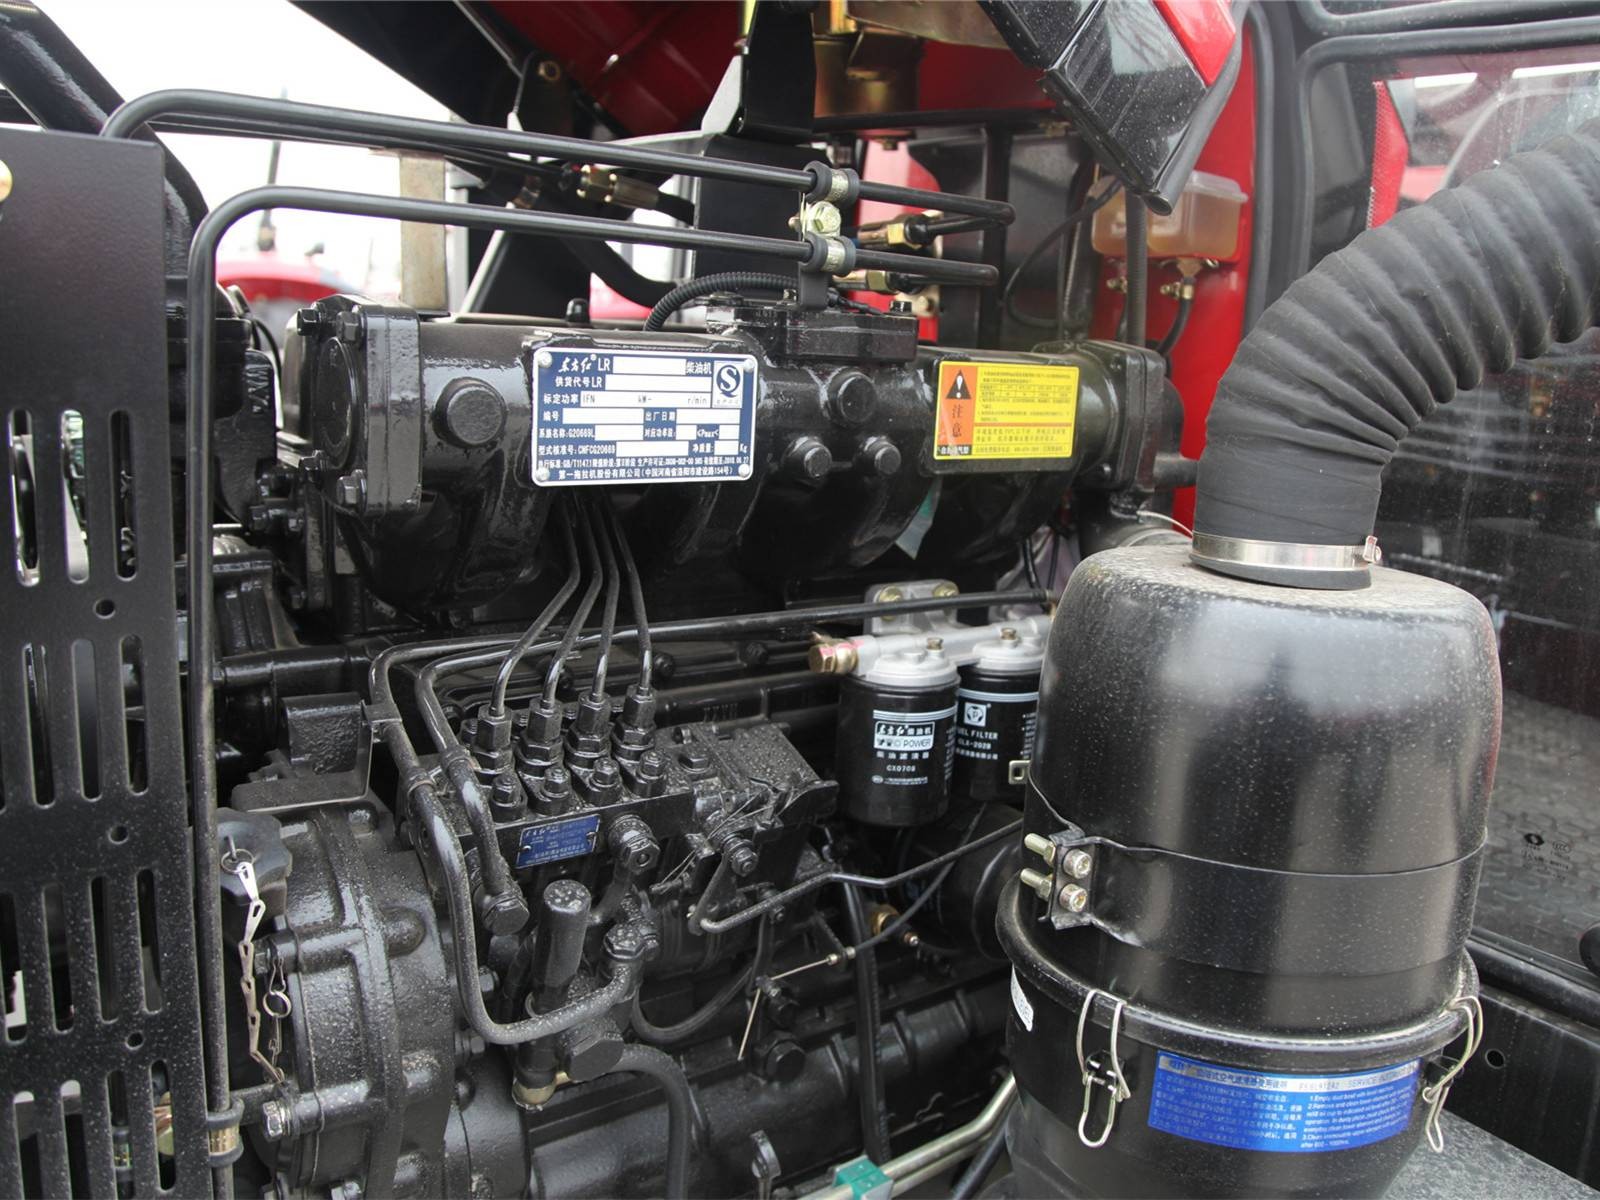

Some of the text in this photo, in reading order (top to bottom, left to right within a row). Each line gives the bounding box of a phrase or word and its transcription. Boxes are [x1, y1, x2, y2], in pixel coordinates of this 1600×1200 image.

[597, 358, 611, 372] LR
[686, 360, 713, 375] 柴油机
[543, 392, 579, 405] 标定功率
[543, 410, 560, 422] 编号
[645, 411, 676, 422] 出厂日期
[951, 403, 964, 438] 注意
[970, 729, 999, 740] FILTER
[903, 738, 931, 748] POWER
